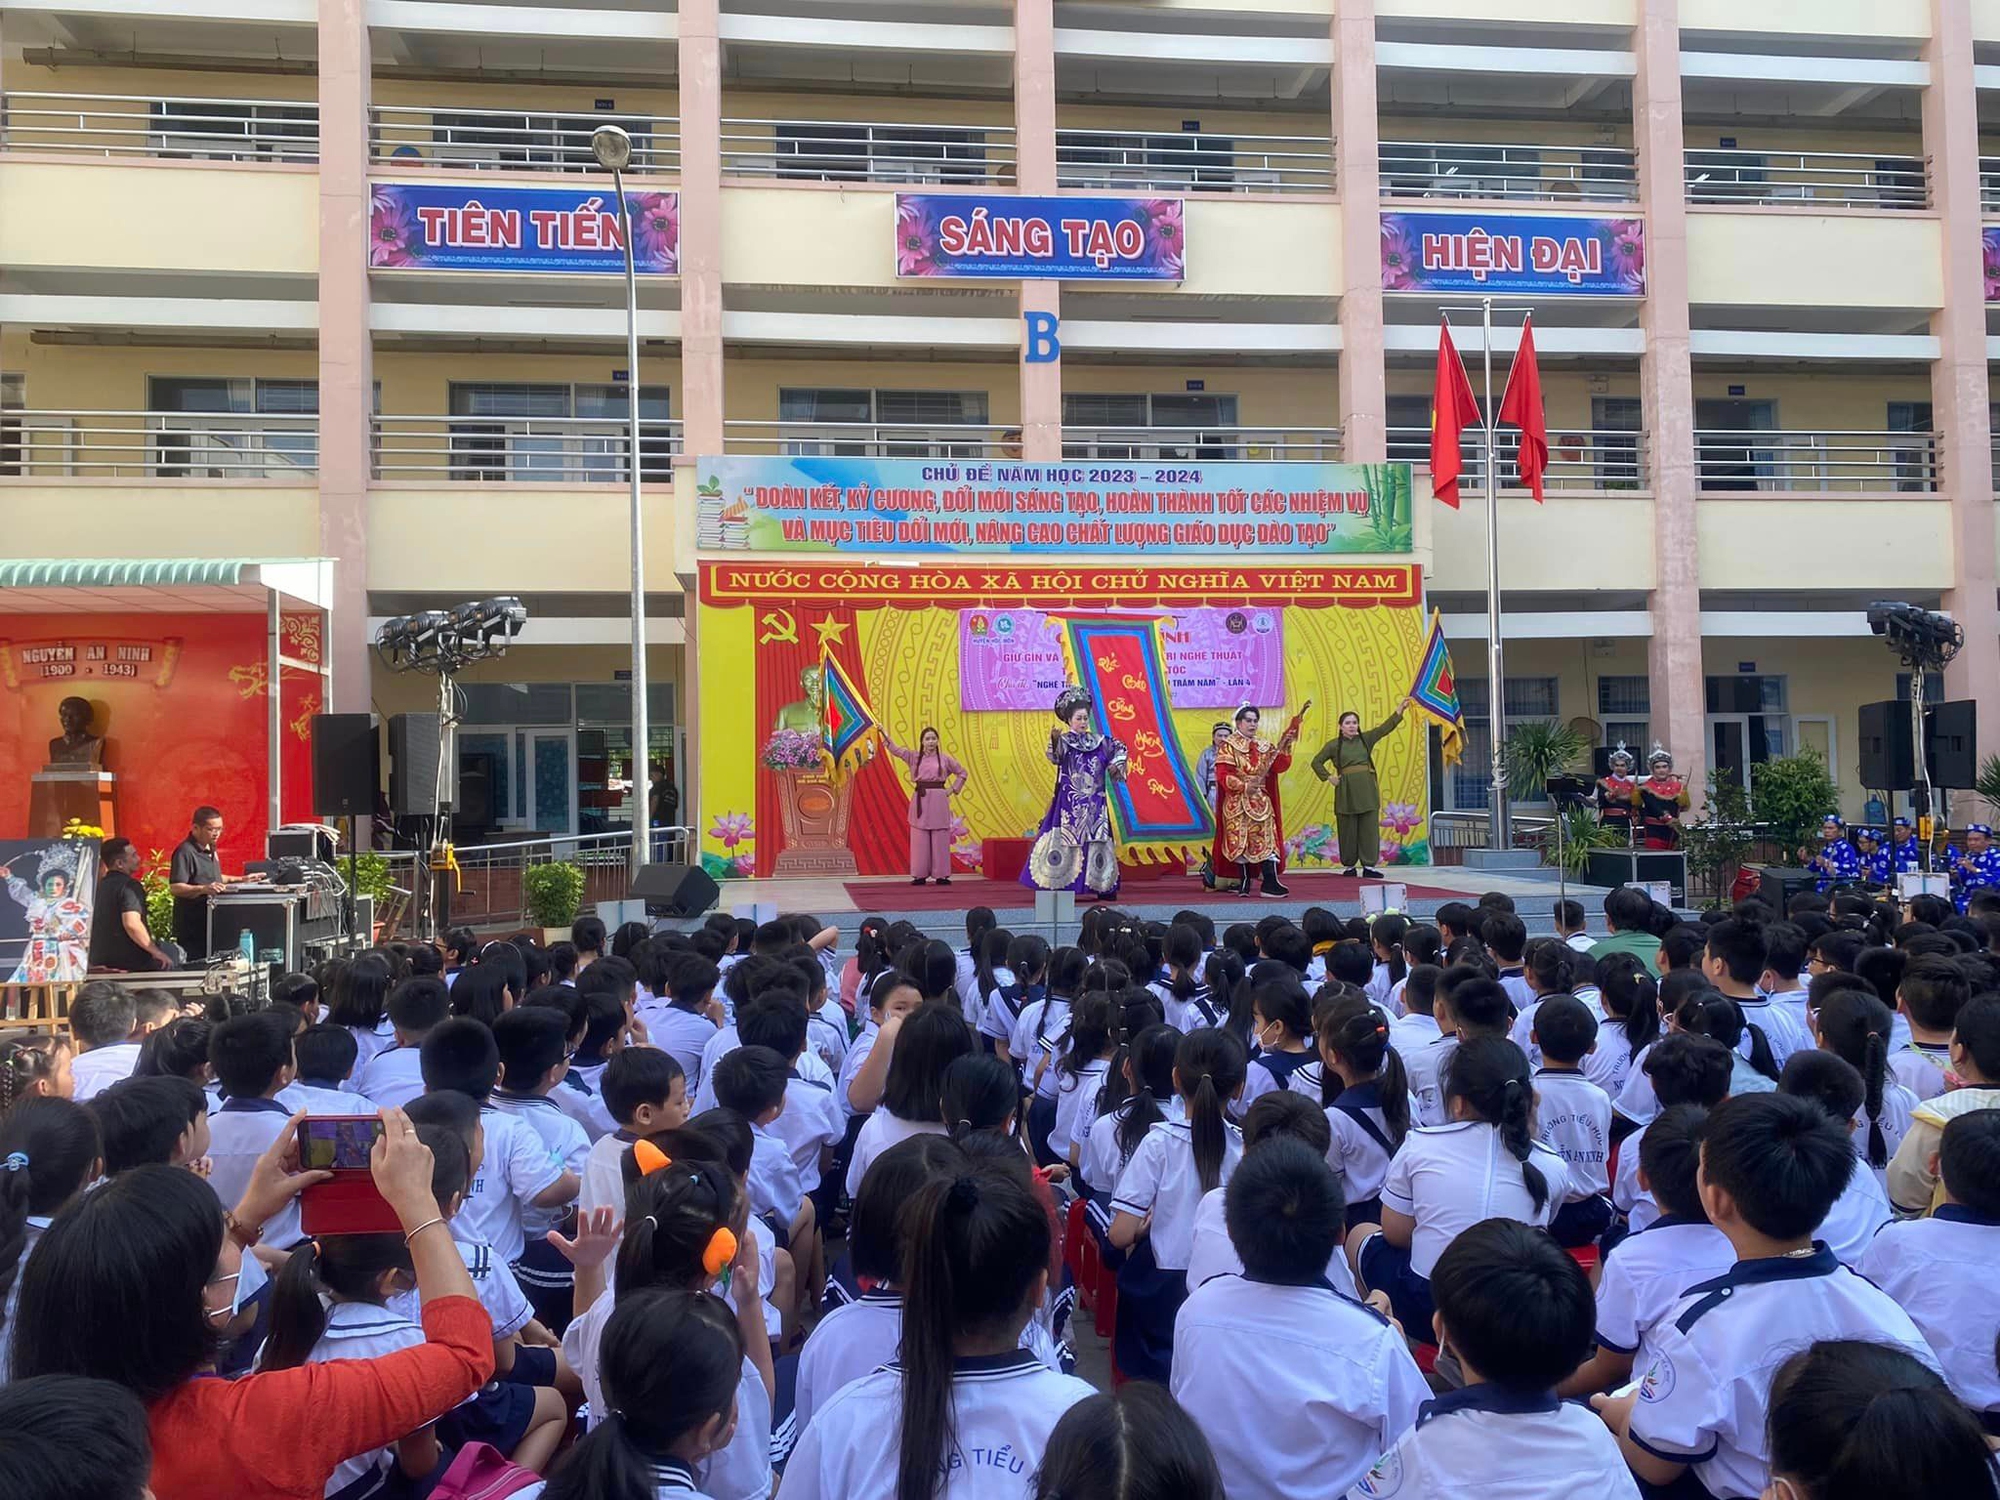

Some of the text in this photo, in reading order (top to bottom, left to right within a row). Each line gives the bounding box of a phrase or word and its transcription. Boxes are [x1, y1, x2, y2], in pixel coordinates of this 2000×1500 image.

[417, 196, 632, 250] TIÊN TIẾN
[939, 206, 1145, 269] SÁNG TẠO
[1422, 227, 1602, 284] HIỆN ĐẠI
[1023, 311, 1061, 364] B
[922, 465, 960, 482] CHỦ
[966, 462, 991, 482] ĐỀ
[998, 464, 1040, 482] NĂM
[1047, 468, 1084, 486] HỌC
[1089, 469, 1136, 484] 2023
[1155, 469, 1202, 484] 2024
[810, 486, 843, 513] KẾT,
[847, 483, 870, 510] KỶ
[873, 488, 940, 513] CƯƠNG,
[943, 485, 972, 512] ĐỔI
[978, 486, 1013, 512] MỚI
[1016, 487, 1063, 514] SÁNG
[1064, 491, 1105, 517] TẠO,
[1106, 489, 1153, 514] HOÀN
[1157, 489, 1213, 514] THÀNH
[1216, 488, 1248, 514] TỐT
[1251, 488, 1287, 514] CÁC
[1289, 490, 1343, 519] NHIỆM
[1347, 491, 1371, 518] VỤ
[781, 515, 807, 542] VÀ
[810, 520, 852, 547] MỤC
[855, 517, 896, 543] TIÊU
[898, 516, 930, 544] ĐỔI
[934, 517, 972, 547] MỚI,
[976, 519, 1022, 544] NÂNG
[1027, 521, 1063, 545] CAO
[1066, 519, 1112, 546] CHẤT
[1115, 521, 1170, 550] LƯỢNG
[1174, 519, 1215, 546] GIÁO
[1218, 523, 1255, 550] DỤC
[1257, 520, 1296, 546] ĐÀO
[729, 568, 1397, 592] NƯỚC CỘNG HÒA XÃ HỘI CHỦ NGHĨA VIỆT NAM
[22, 641, 151, 663] NGUYỄN AN NINH
[973, 1444, 1024, 1474] TIỂU
